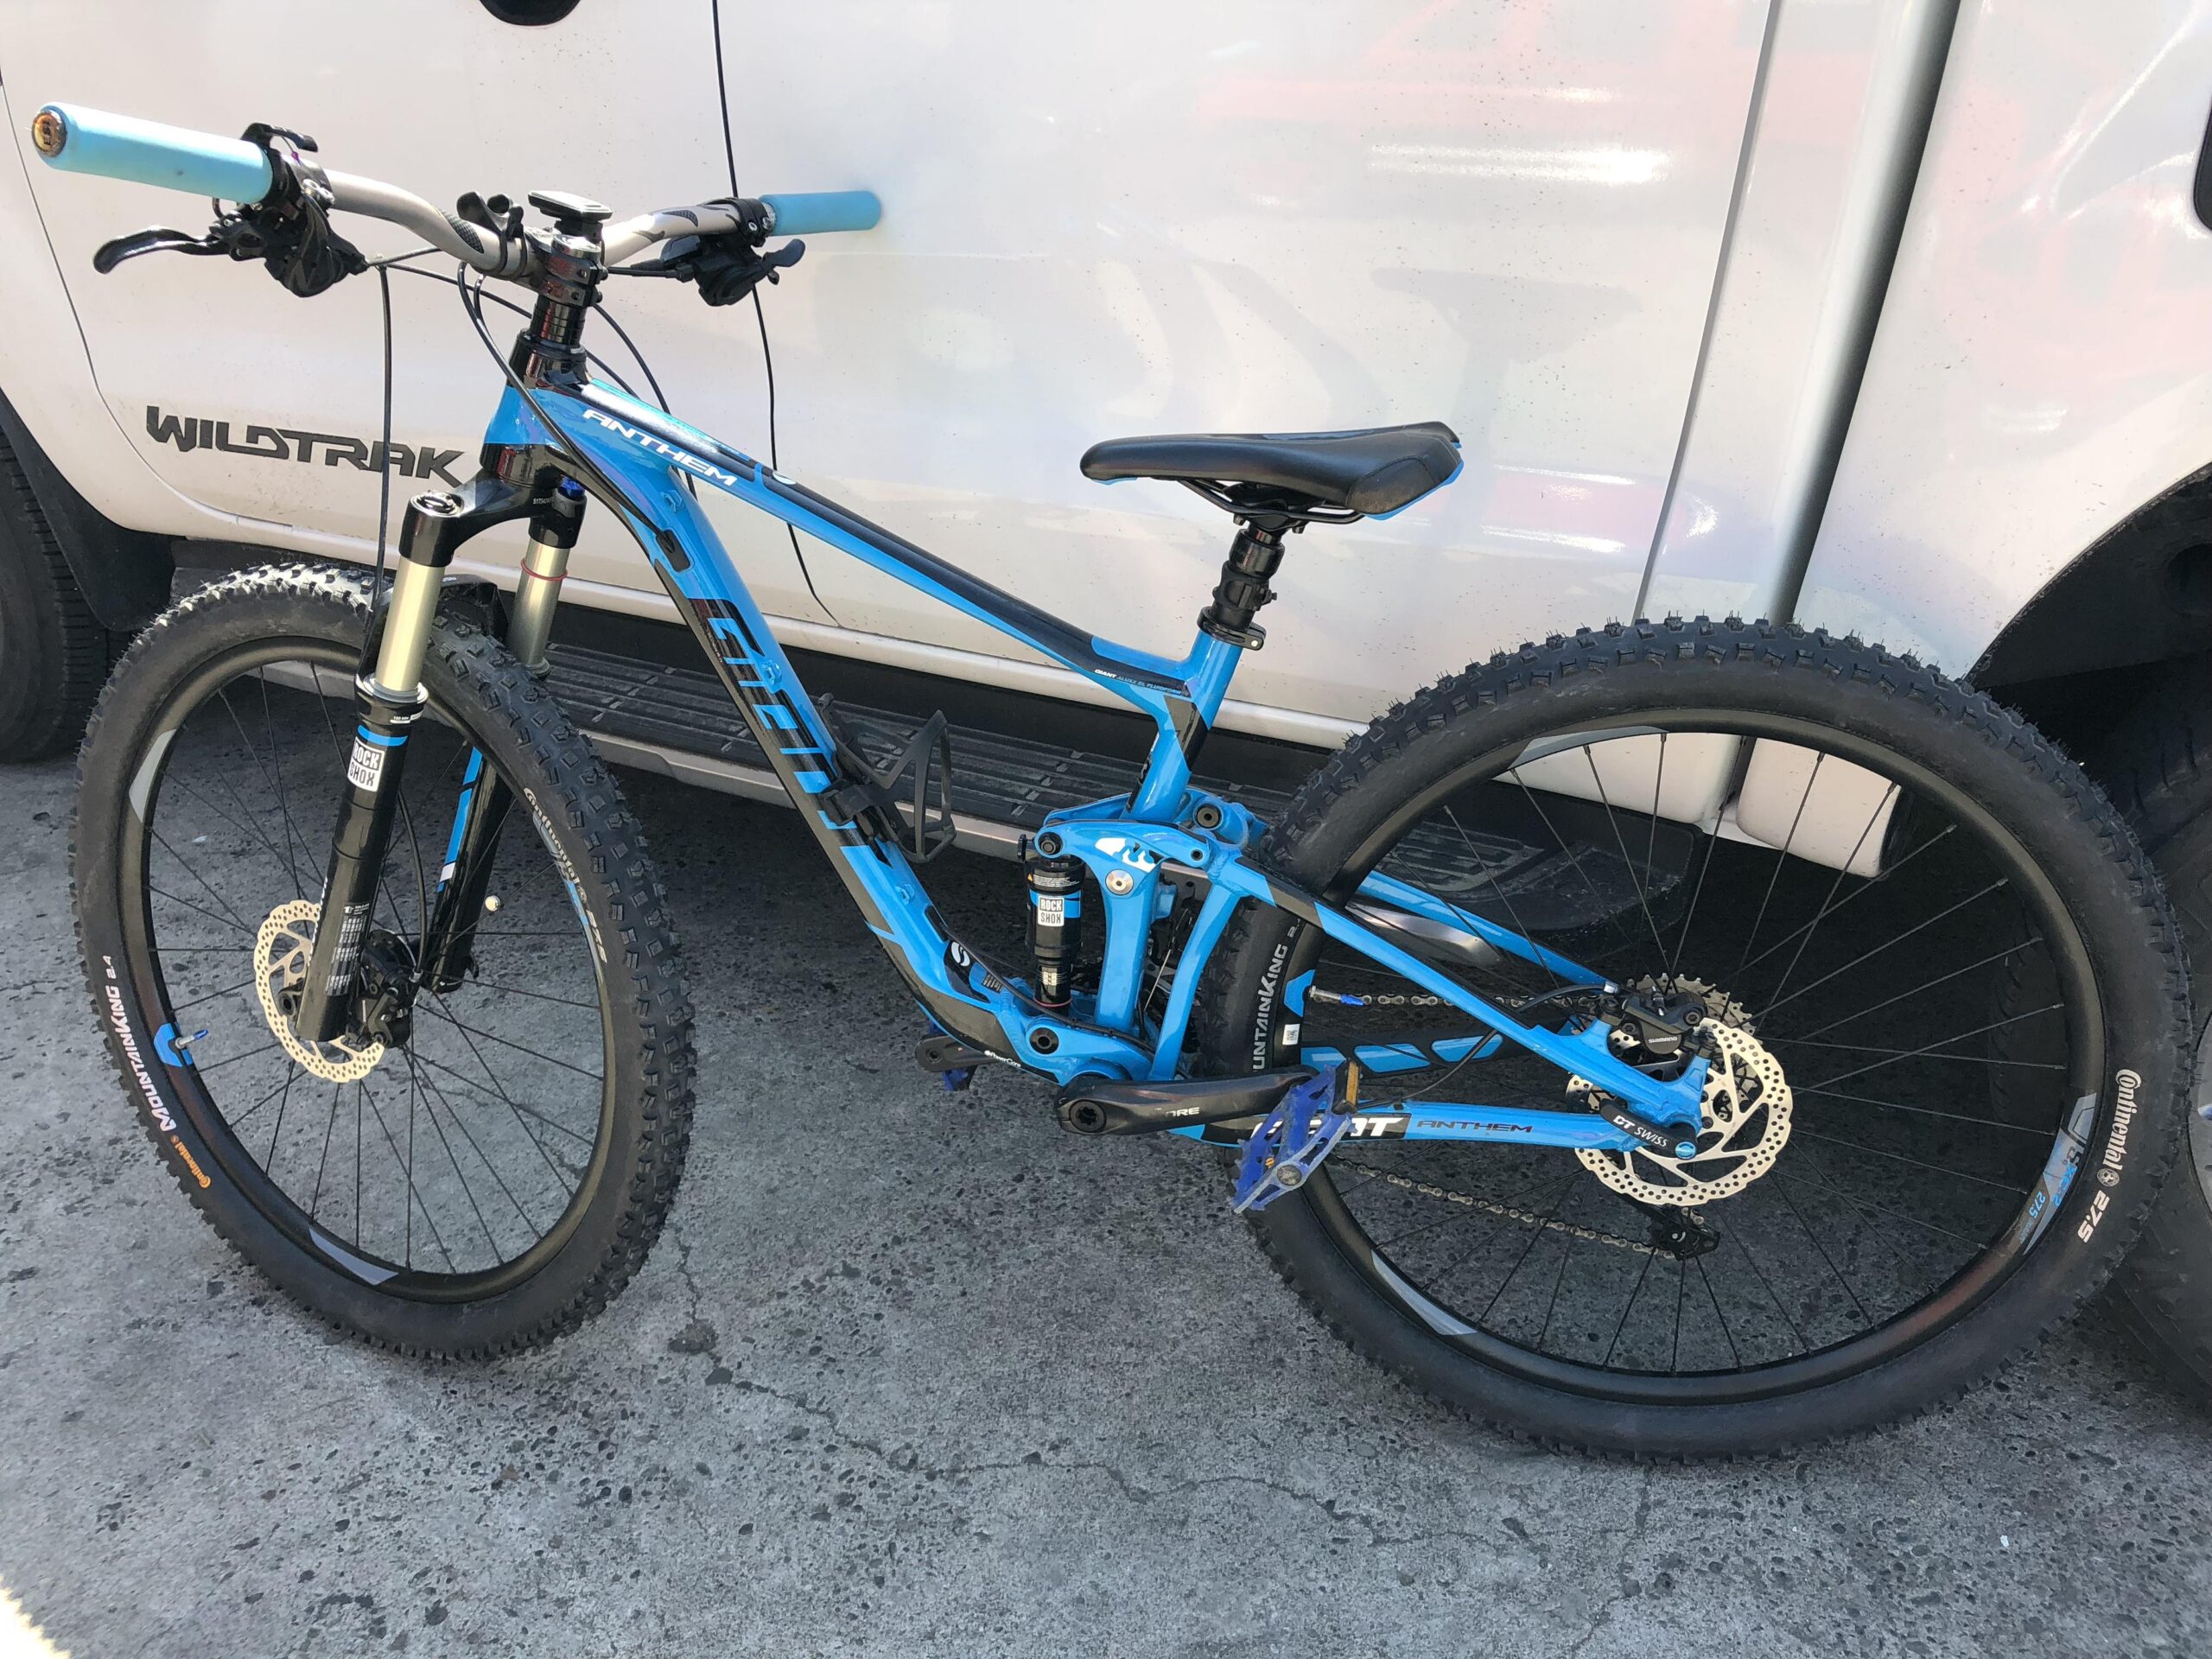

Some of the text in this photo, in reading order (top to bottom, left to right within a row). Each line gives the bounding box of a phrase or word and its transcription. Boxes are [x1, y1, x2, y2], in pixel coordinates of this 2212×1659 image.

[146, 405, 466, 489] WILDTRAK
[582, 409, 738, 486] ANTHEM
[1094, 669, 1117, 678] GIANT
[353, 741, 380, 769] ROCK
[349, 761, 375, 786] SHOX
[524, 787, 581, 884] Continental
[586, 909, 607, 963] 27.5
[1040, 899, 1062, 911] ROCK
[1040, 912, 1061, 924] SHOX
[102, 955, 117, 980] 2.4
[1253, 944, 1288, 1071] UNTAINKING
[1417, 1120, 1533, 1133] ANTHEM
[1613, 1115, 1669, 1147] DT SWISS
[2077, 1069, 2142, 1243] Continental 27.5
